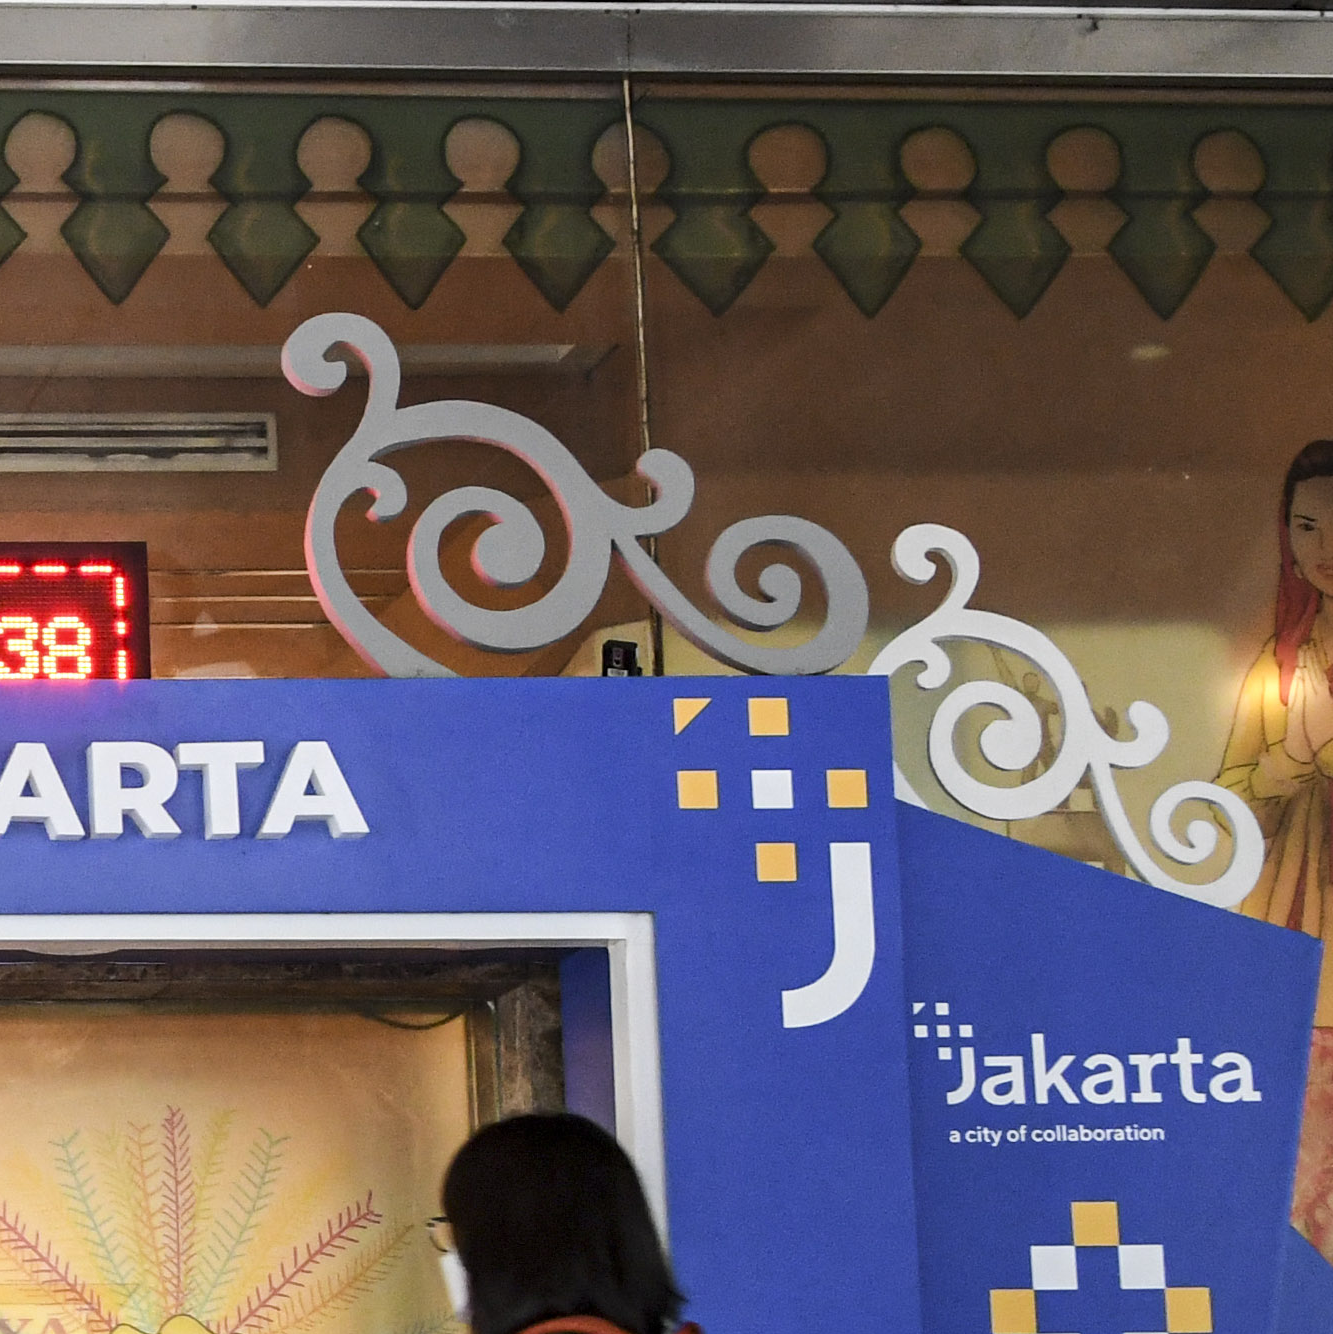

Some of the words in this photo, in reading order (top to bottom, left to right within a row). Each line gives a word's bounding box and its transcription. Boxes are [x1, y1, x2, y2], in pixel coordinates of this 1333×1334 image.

[949, 1128, 962, 1143] a
[964, 1126, 1002, 1147] city
[1006, 1125, 1027, 1143] of
[1031, 1125, 1165, 1142] collaboration
